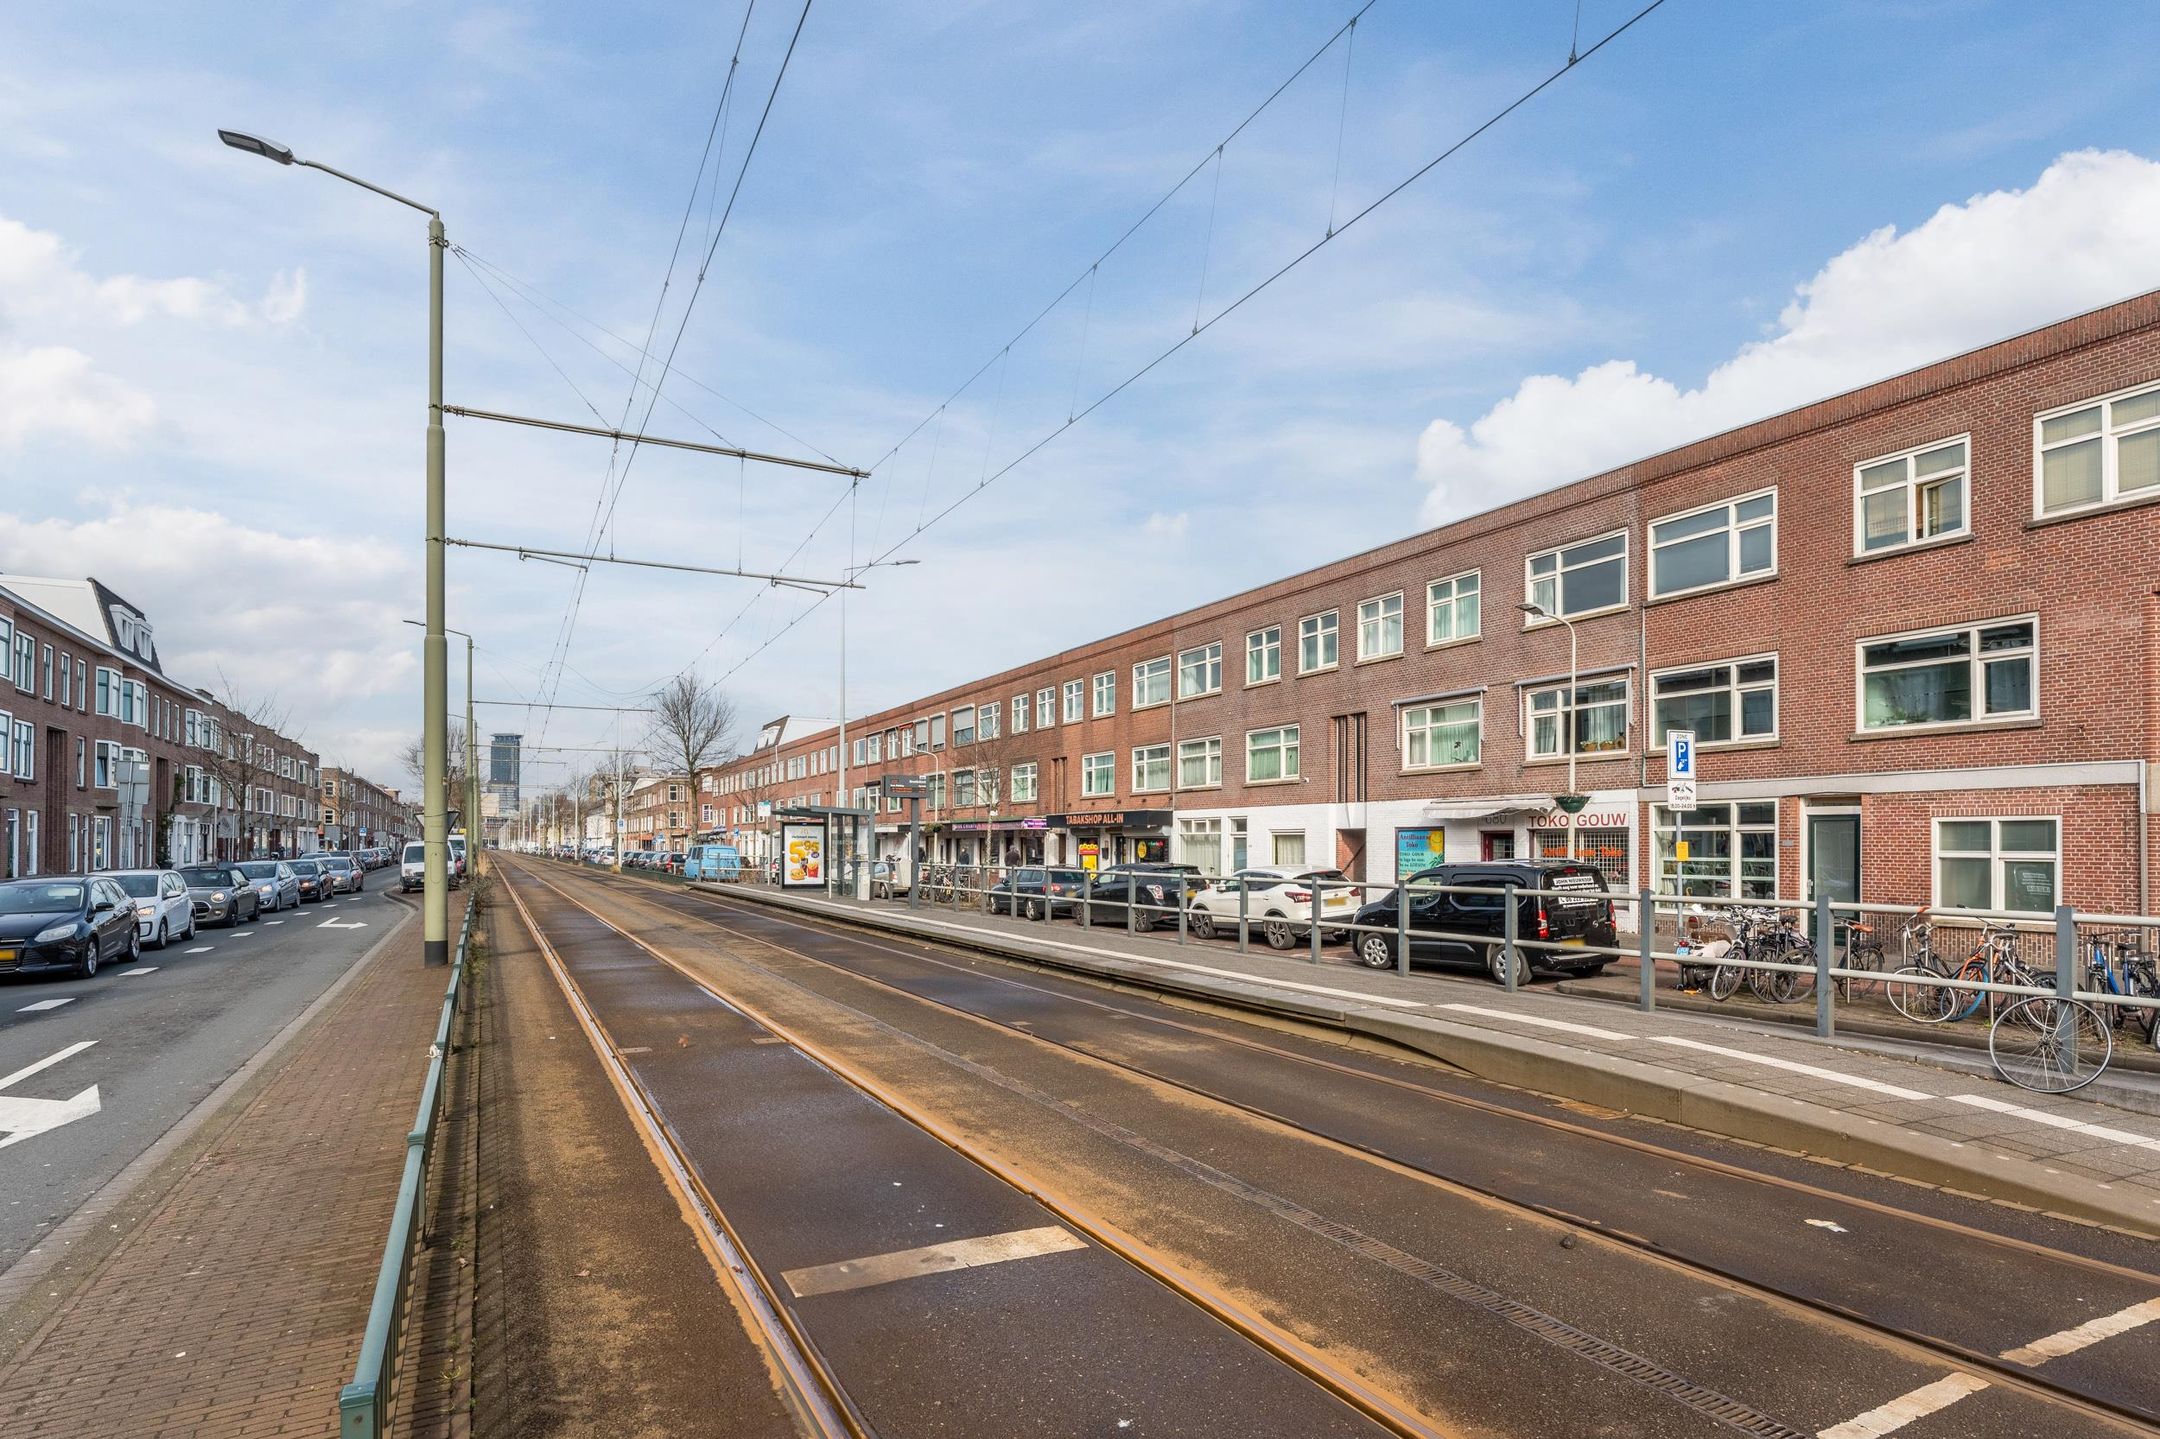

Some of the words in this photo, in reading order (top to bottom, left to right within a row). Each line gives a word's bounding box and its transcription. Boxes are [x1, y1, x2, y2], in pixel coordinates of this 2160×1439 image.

[1678, 742, 1687, 758] P
[1065, 814, 1102, 825] TABAKSHOP
[1103, 813, 1124, 824] ALL-IN
[1528, 815, 1569, 827] TOKO
[1576, 813, 1626, 827] GOUW
[1600, 845, 1623, 857] Toko
